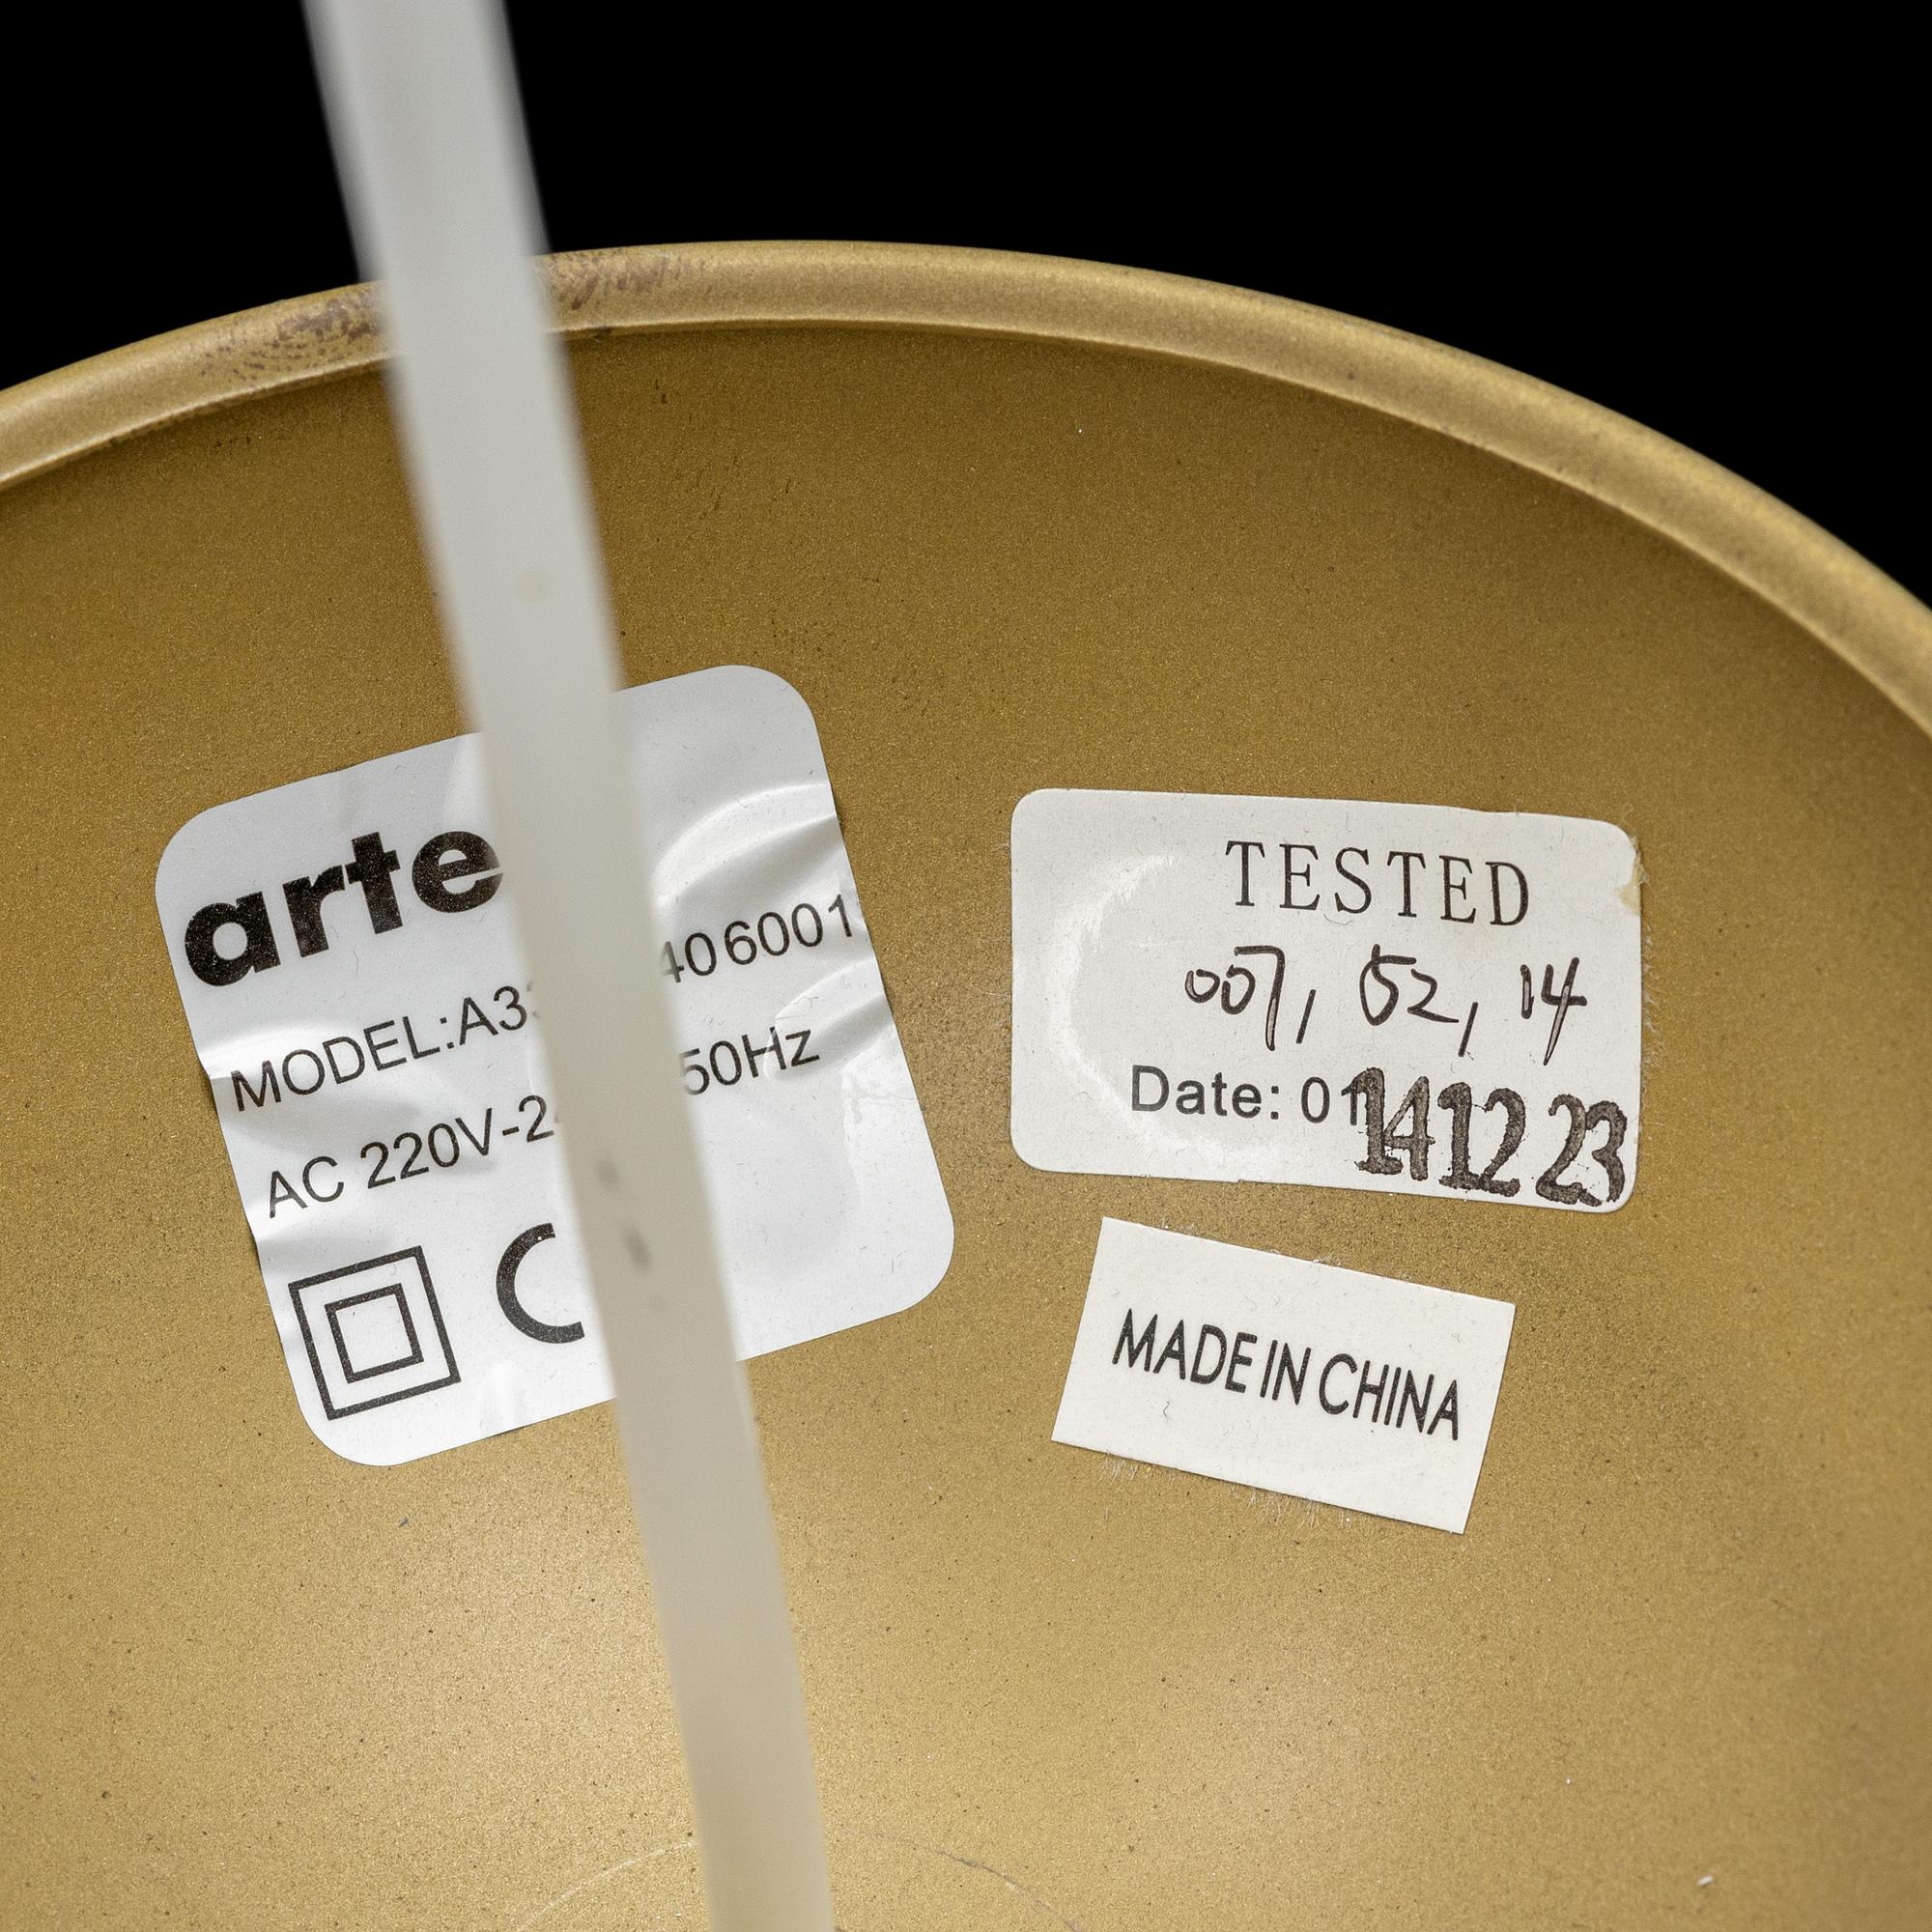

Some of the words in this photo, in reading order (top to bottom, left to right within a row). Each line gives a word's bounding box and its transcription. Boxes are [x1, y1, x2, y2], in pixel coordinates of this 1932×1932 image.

[1225, 839, 1529, 926] TESTED
[230, 980, 539, 1112] MODEL:A3
[1131, 1065, 1280, 1121] Date:
[269, 1155, 344, 1219] AC
[359, 1094, 561, 1189] 220V-2
[1112, 1307, 1258, 1394] MADE
[1260, 1339, 1312, 1406] IN
[1318, 1353, 1460, 1441] CHINA
